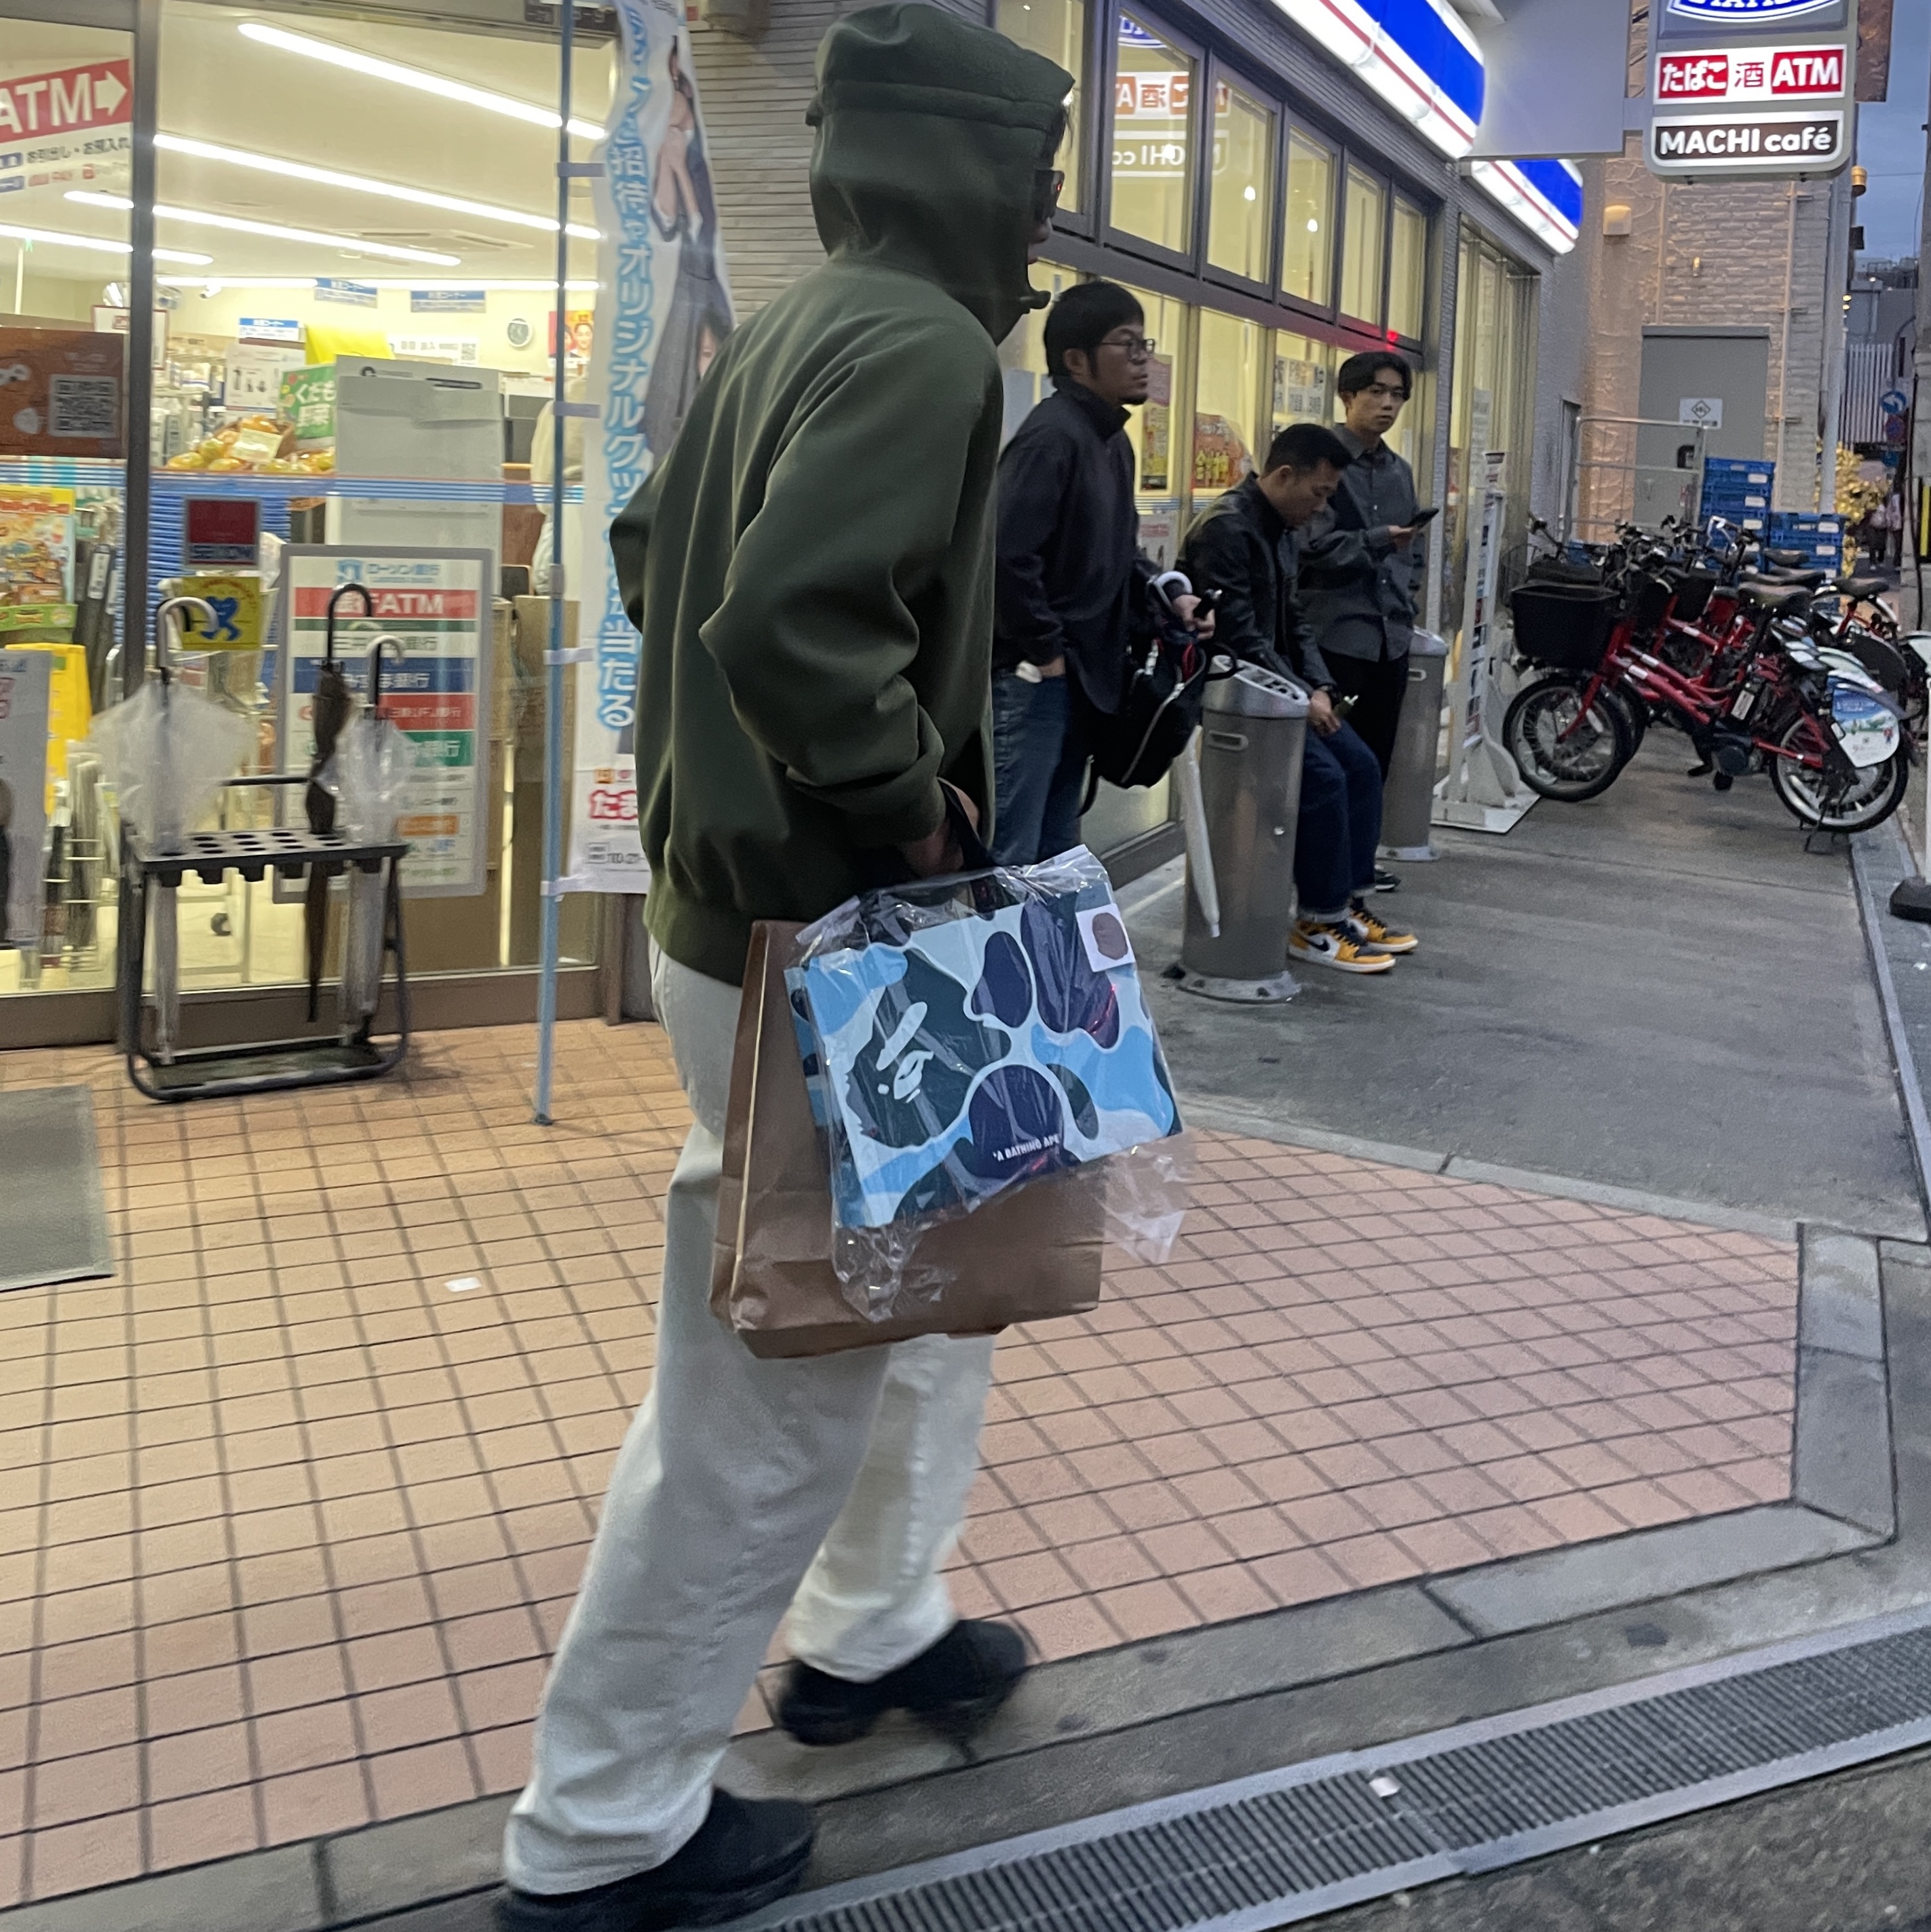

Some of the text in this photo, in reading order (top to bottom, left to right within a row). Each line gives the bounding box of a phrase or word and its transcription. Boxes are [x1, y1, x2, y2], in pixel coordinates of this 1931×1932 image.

[1662, 56, 1840, 92] たばこ 酒 ATM
[0, 73, 94, 134] ATM
[1660, 126, 1832, 155] MACHI café
